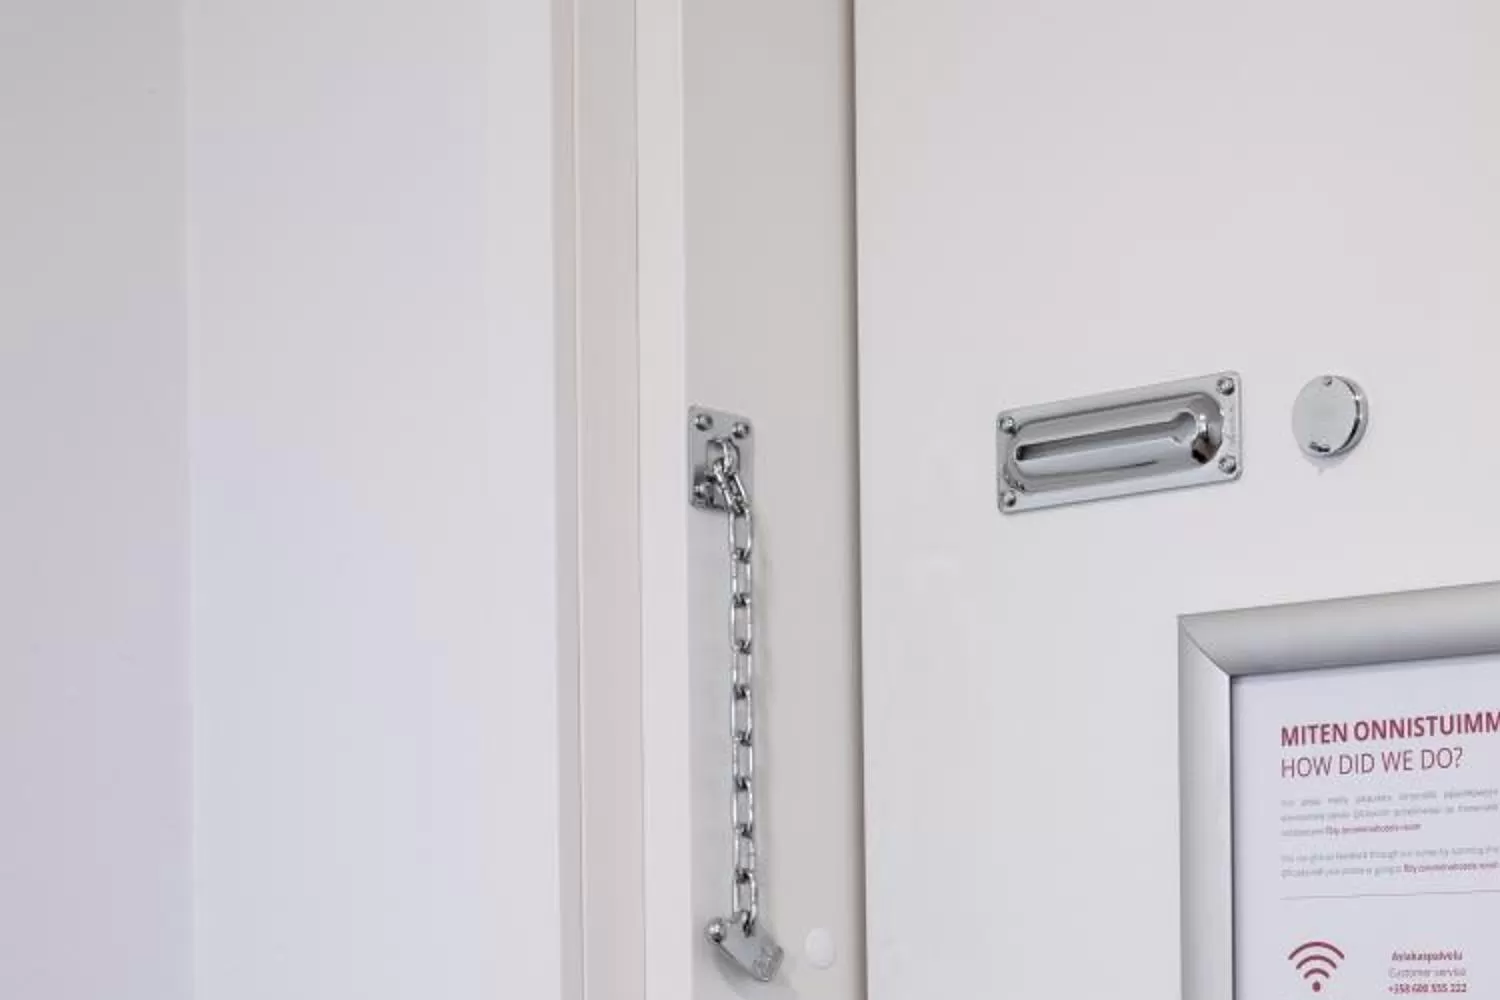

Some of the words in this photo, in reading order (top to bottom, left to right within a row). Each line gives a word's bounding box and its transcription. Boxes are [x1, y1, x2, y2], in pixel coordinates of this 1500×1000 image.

[1280, 722, 1348, 748] MITEN
[1280, 756, 1332, 779] HOW
[1338, 752, 1376, 775] DID
[1380, 750, 1414, 772] WE
[1420, 747, 1464, 770] DO?
